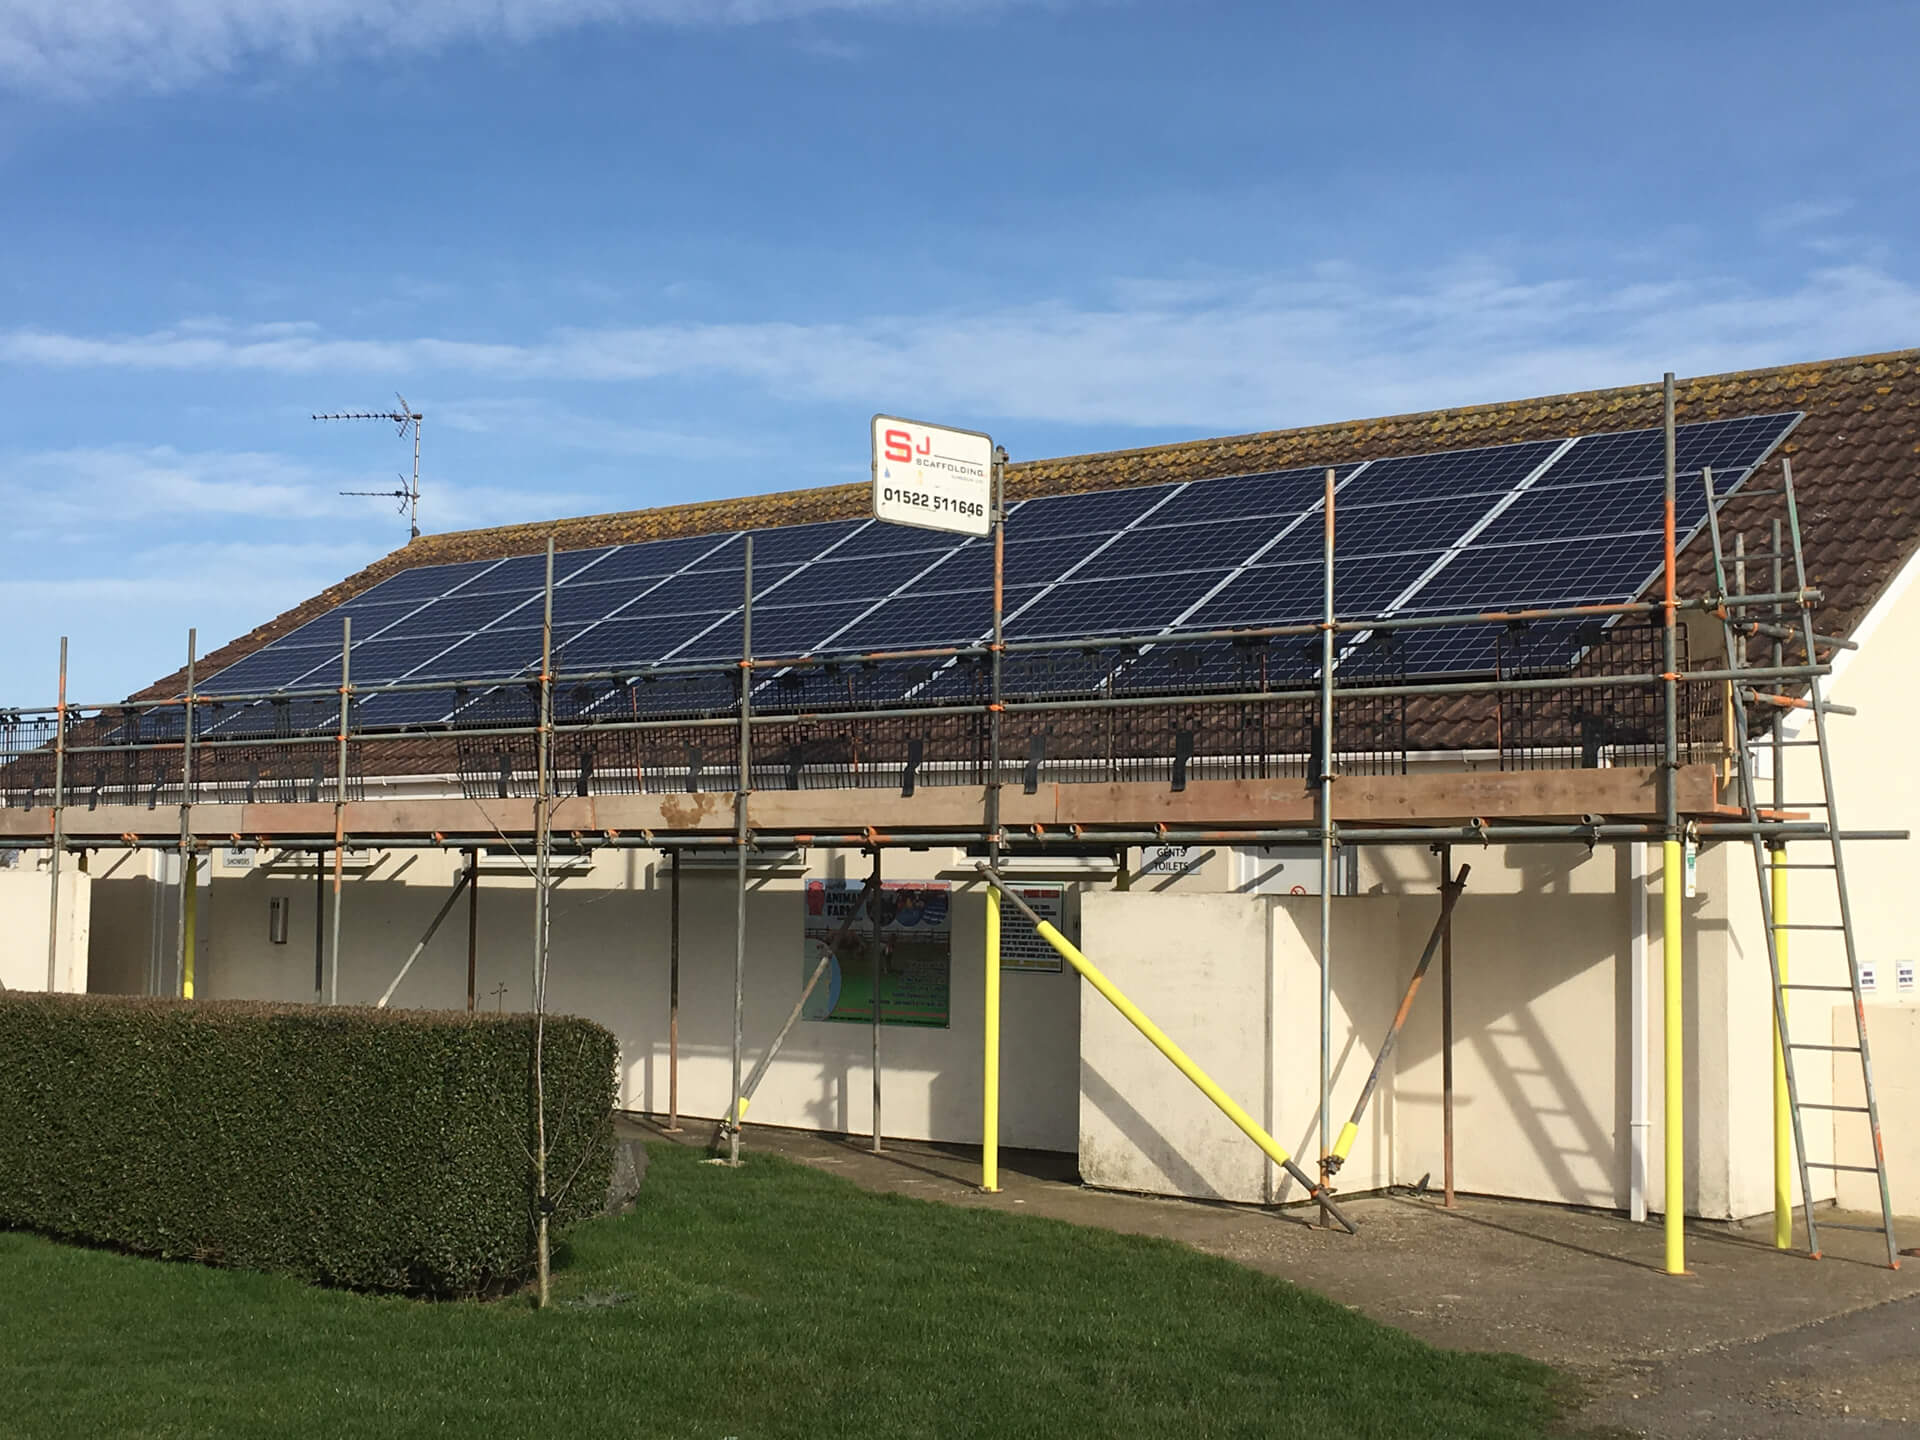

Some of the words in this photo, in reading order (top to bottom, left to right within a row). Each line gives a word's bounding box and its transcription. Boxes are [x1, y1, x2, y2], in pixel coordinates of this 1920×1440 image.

[885, 429, 930, 463] SJ
[916, 458, 984, 477] SCAFFOLDING
[884, 488, 929, 507] 01522
[934, 496, 984, 517] 511646
[1156, 847, 1187, 857] GENTS
[1154, 861, 1189, 871] TOILETS
